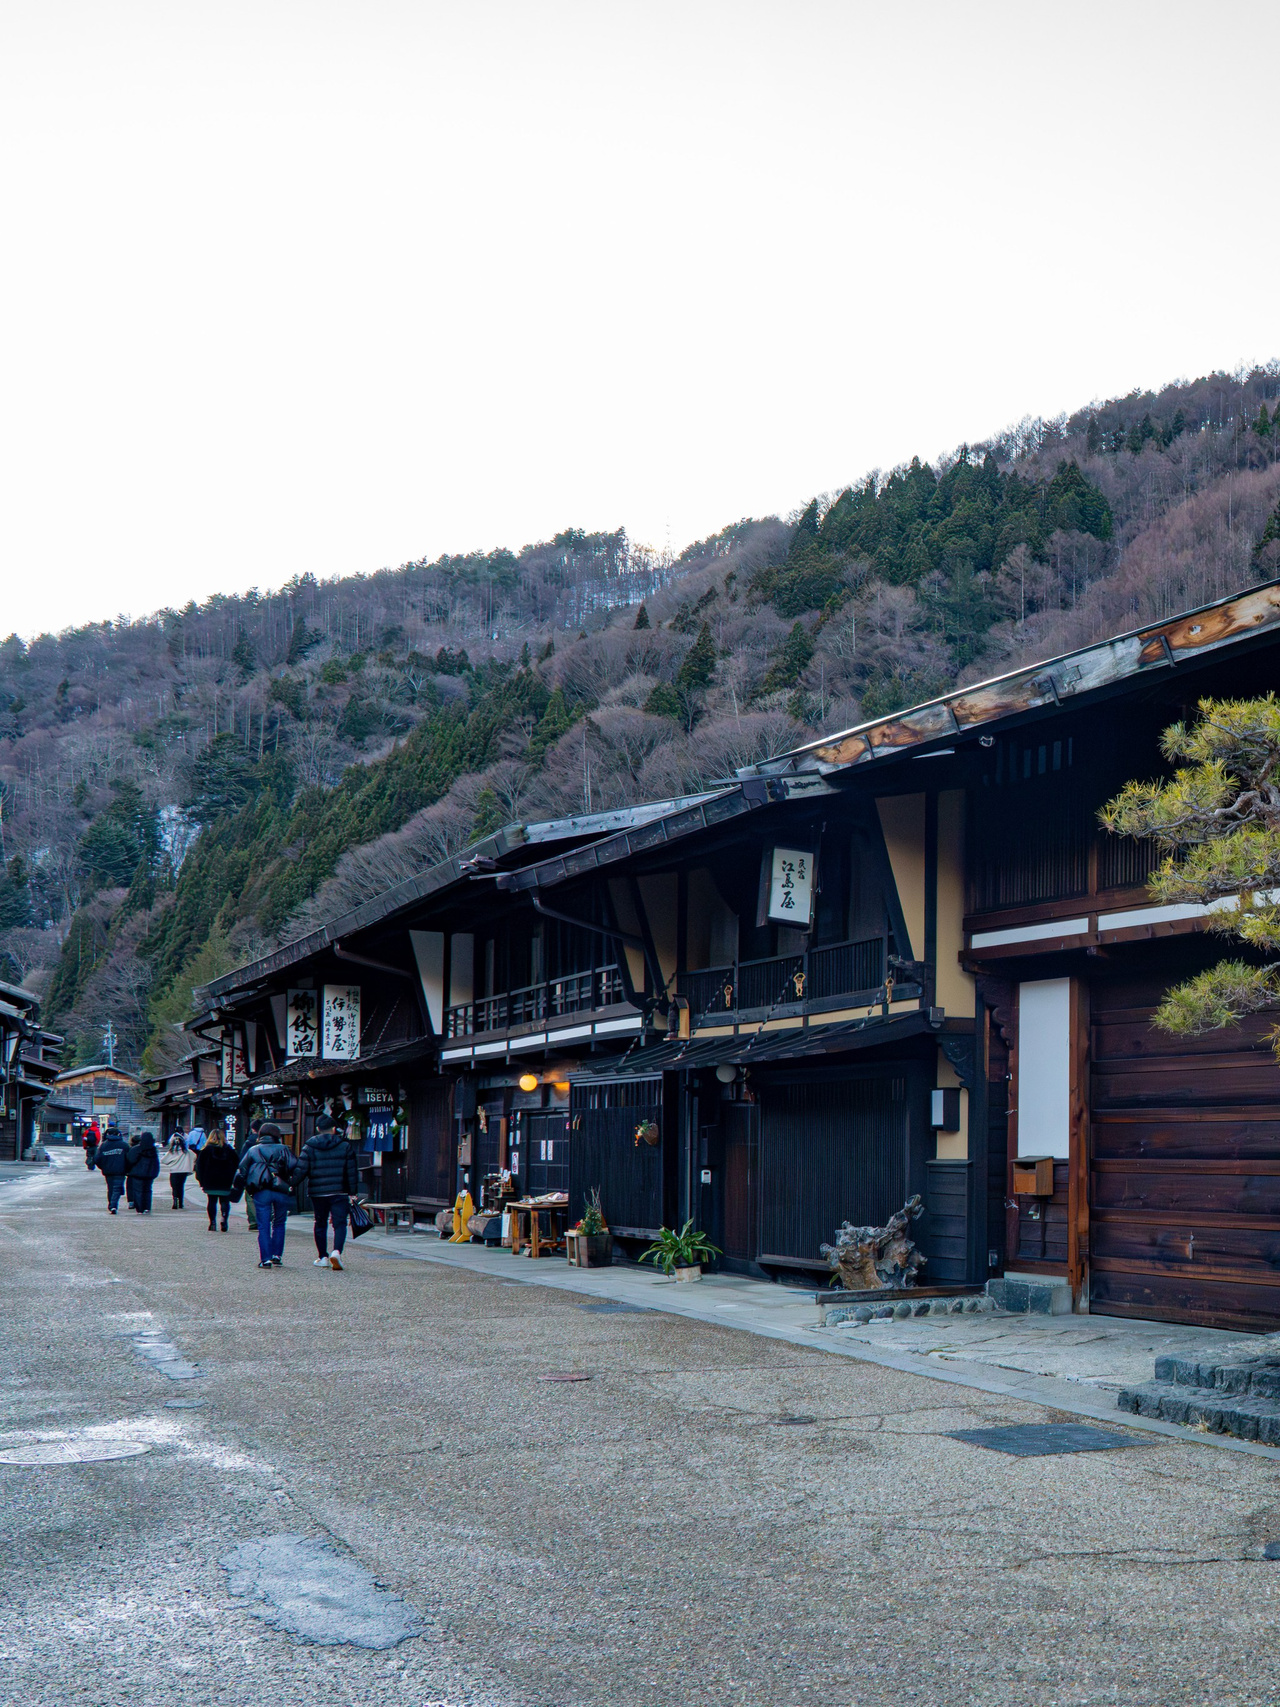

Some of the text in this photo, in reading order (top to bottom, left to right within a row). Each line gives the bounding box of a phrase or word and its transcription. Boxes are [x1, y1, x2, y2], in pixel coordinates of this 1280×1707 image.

[331, 996, 347, 1052] 伊勢屋
[366, 1093, 394, 1102] ISEYA
